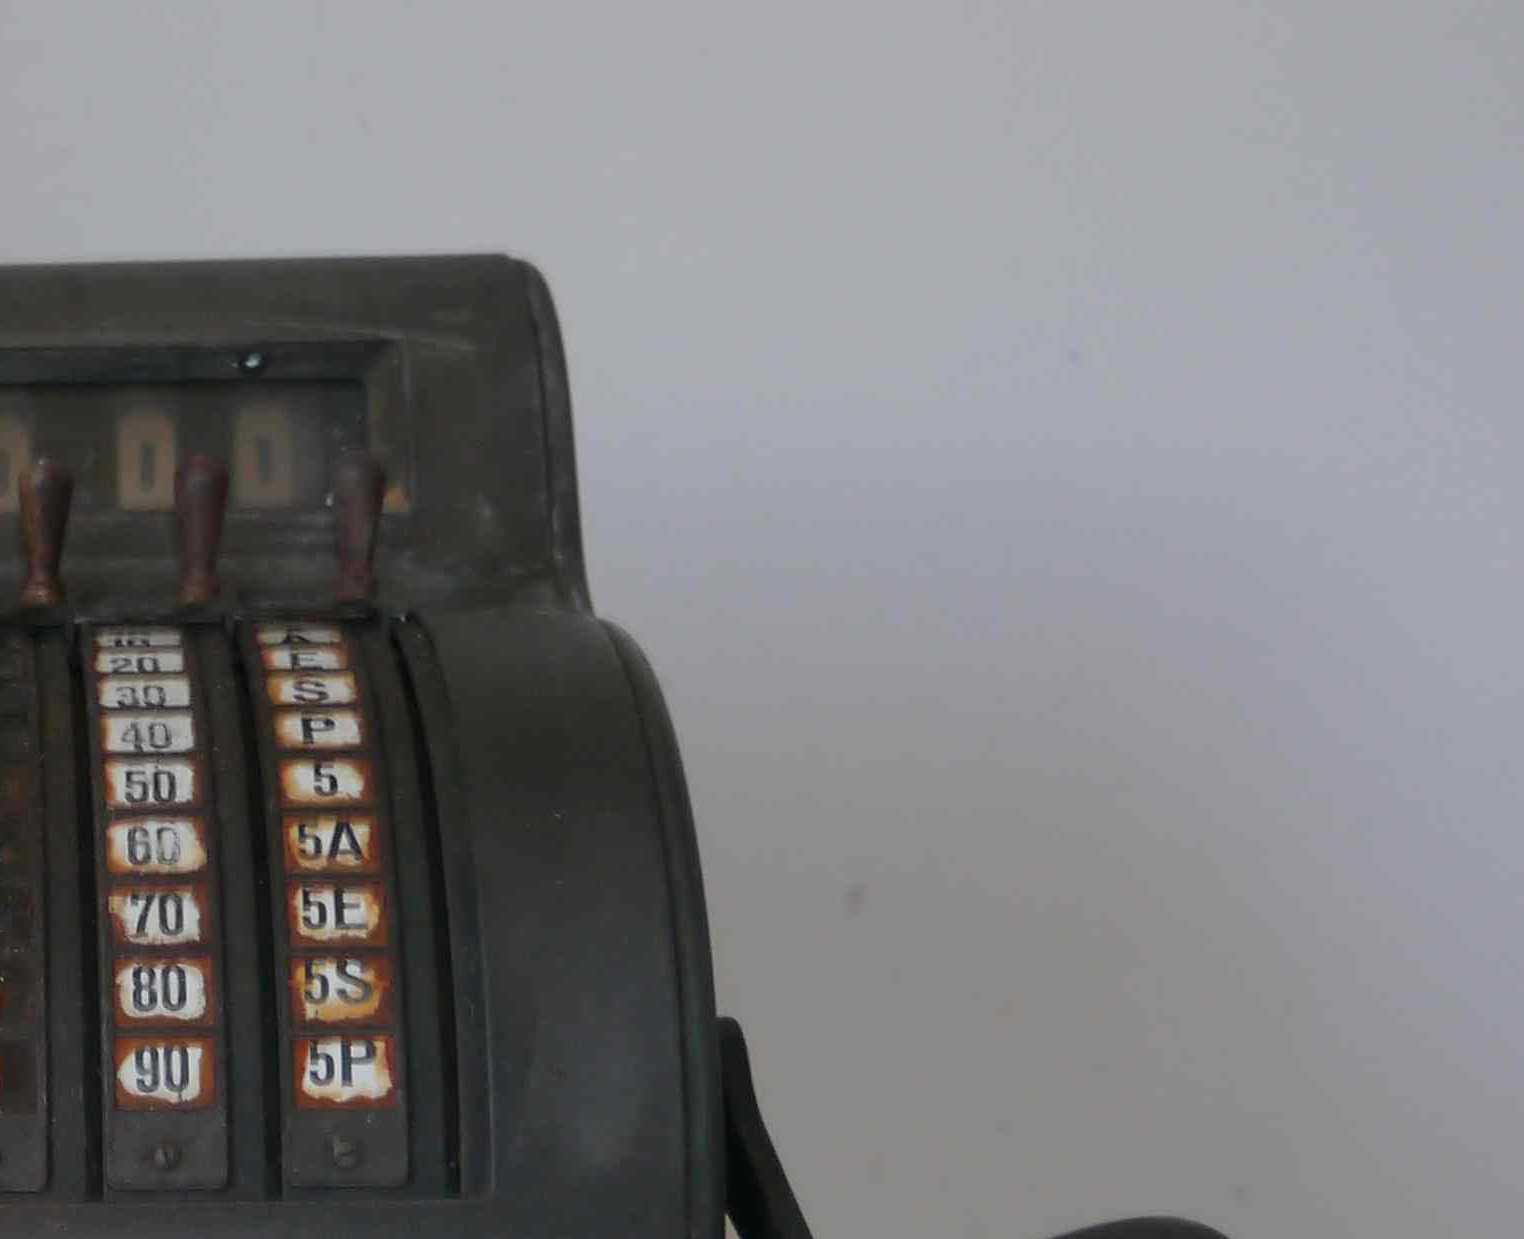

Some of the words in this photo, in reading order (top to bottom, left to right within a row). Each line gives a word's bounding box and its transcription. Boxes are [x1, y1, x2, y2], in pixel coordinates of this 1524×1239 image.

[109, 656, 160, 674] 20
[115, 685, 167, 709] 30
[293, 679, 330, 701] S
[120, 721, 173, 752] 40
[300, 714, 337, 745] P
[125, 769, 177, 803] 50
[313, 758, 338, 798] 5
[126, 826, 181, 866] 60
[297, 820, 364, 862] 5A
[128, 892, 185, 938] 70
[301, 886, 368, 931] 5E
[131, 963, 188, 1012] 80
[303, 957, 373, 1005] 5S
[133, 1045, 191, 1094] 90
[309, 1038, 378, 1089] 5P
